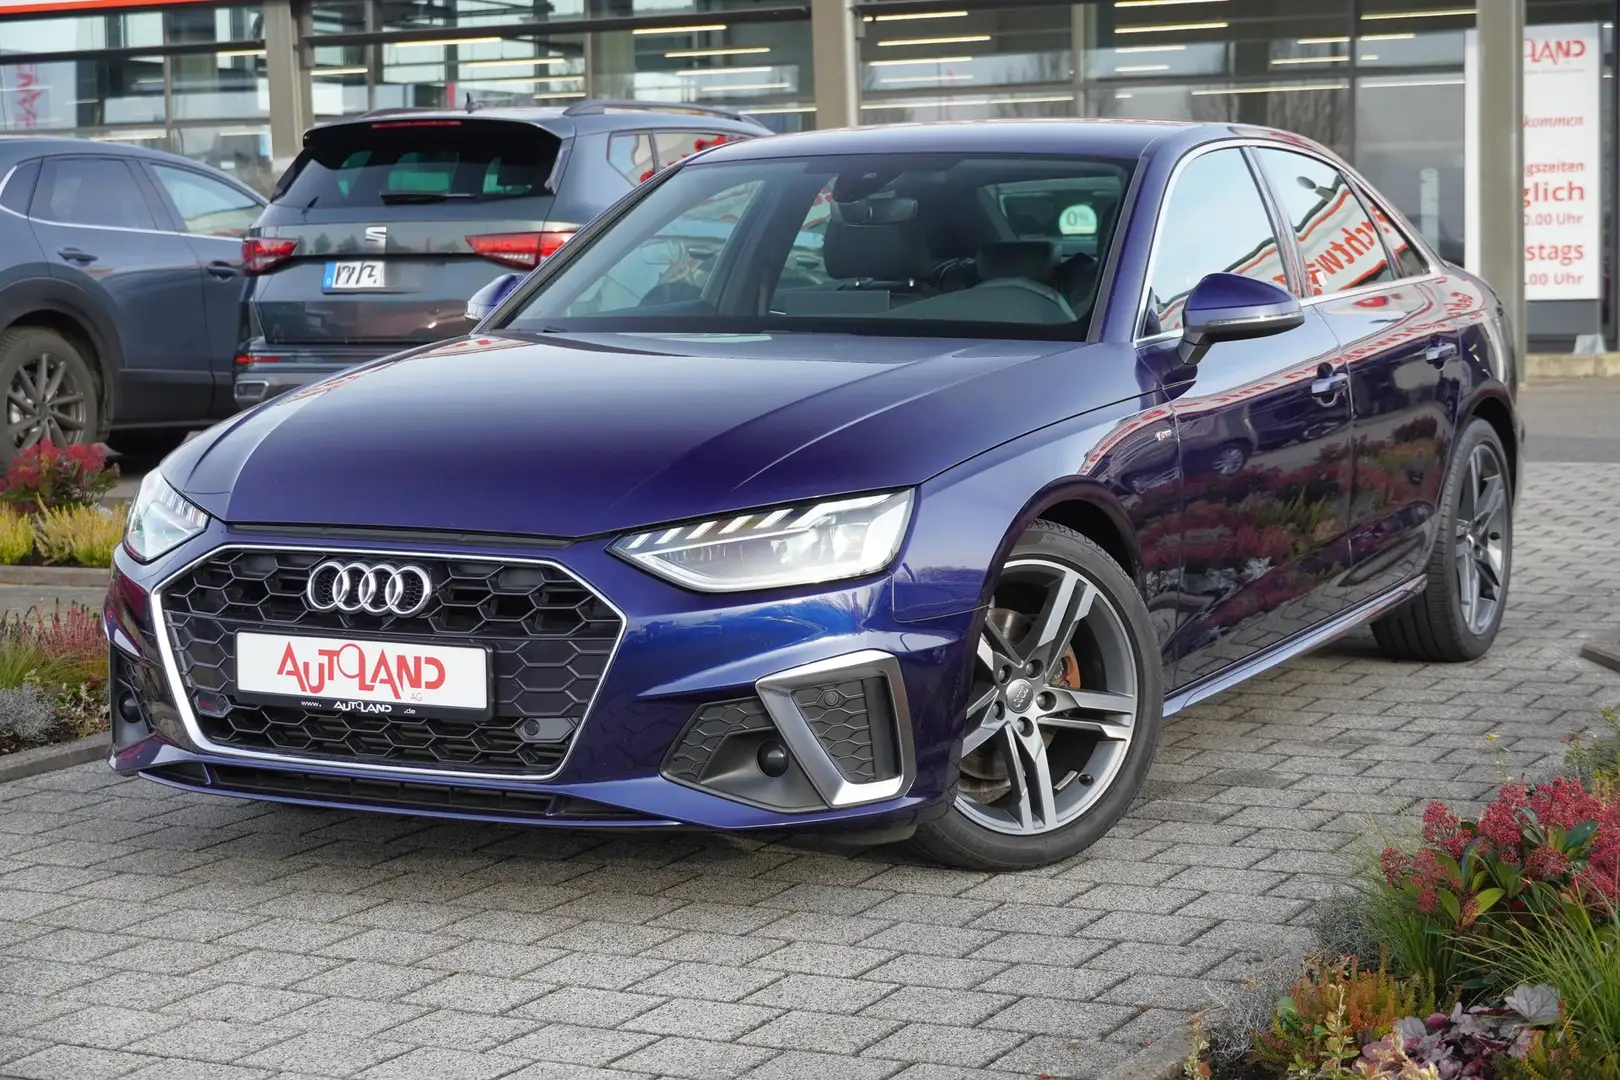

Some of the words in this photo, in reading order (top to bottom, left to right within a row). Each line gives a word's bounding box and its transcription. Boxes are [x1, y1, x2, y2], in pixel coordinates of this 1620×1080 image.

[1556, 212, 1583, 226] Uhr
[1553, 271, 1583, 286] Uhr
[410, 692, 423, 702] AG
